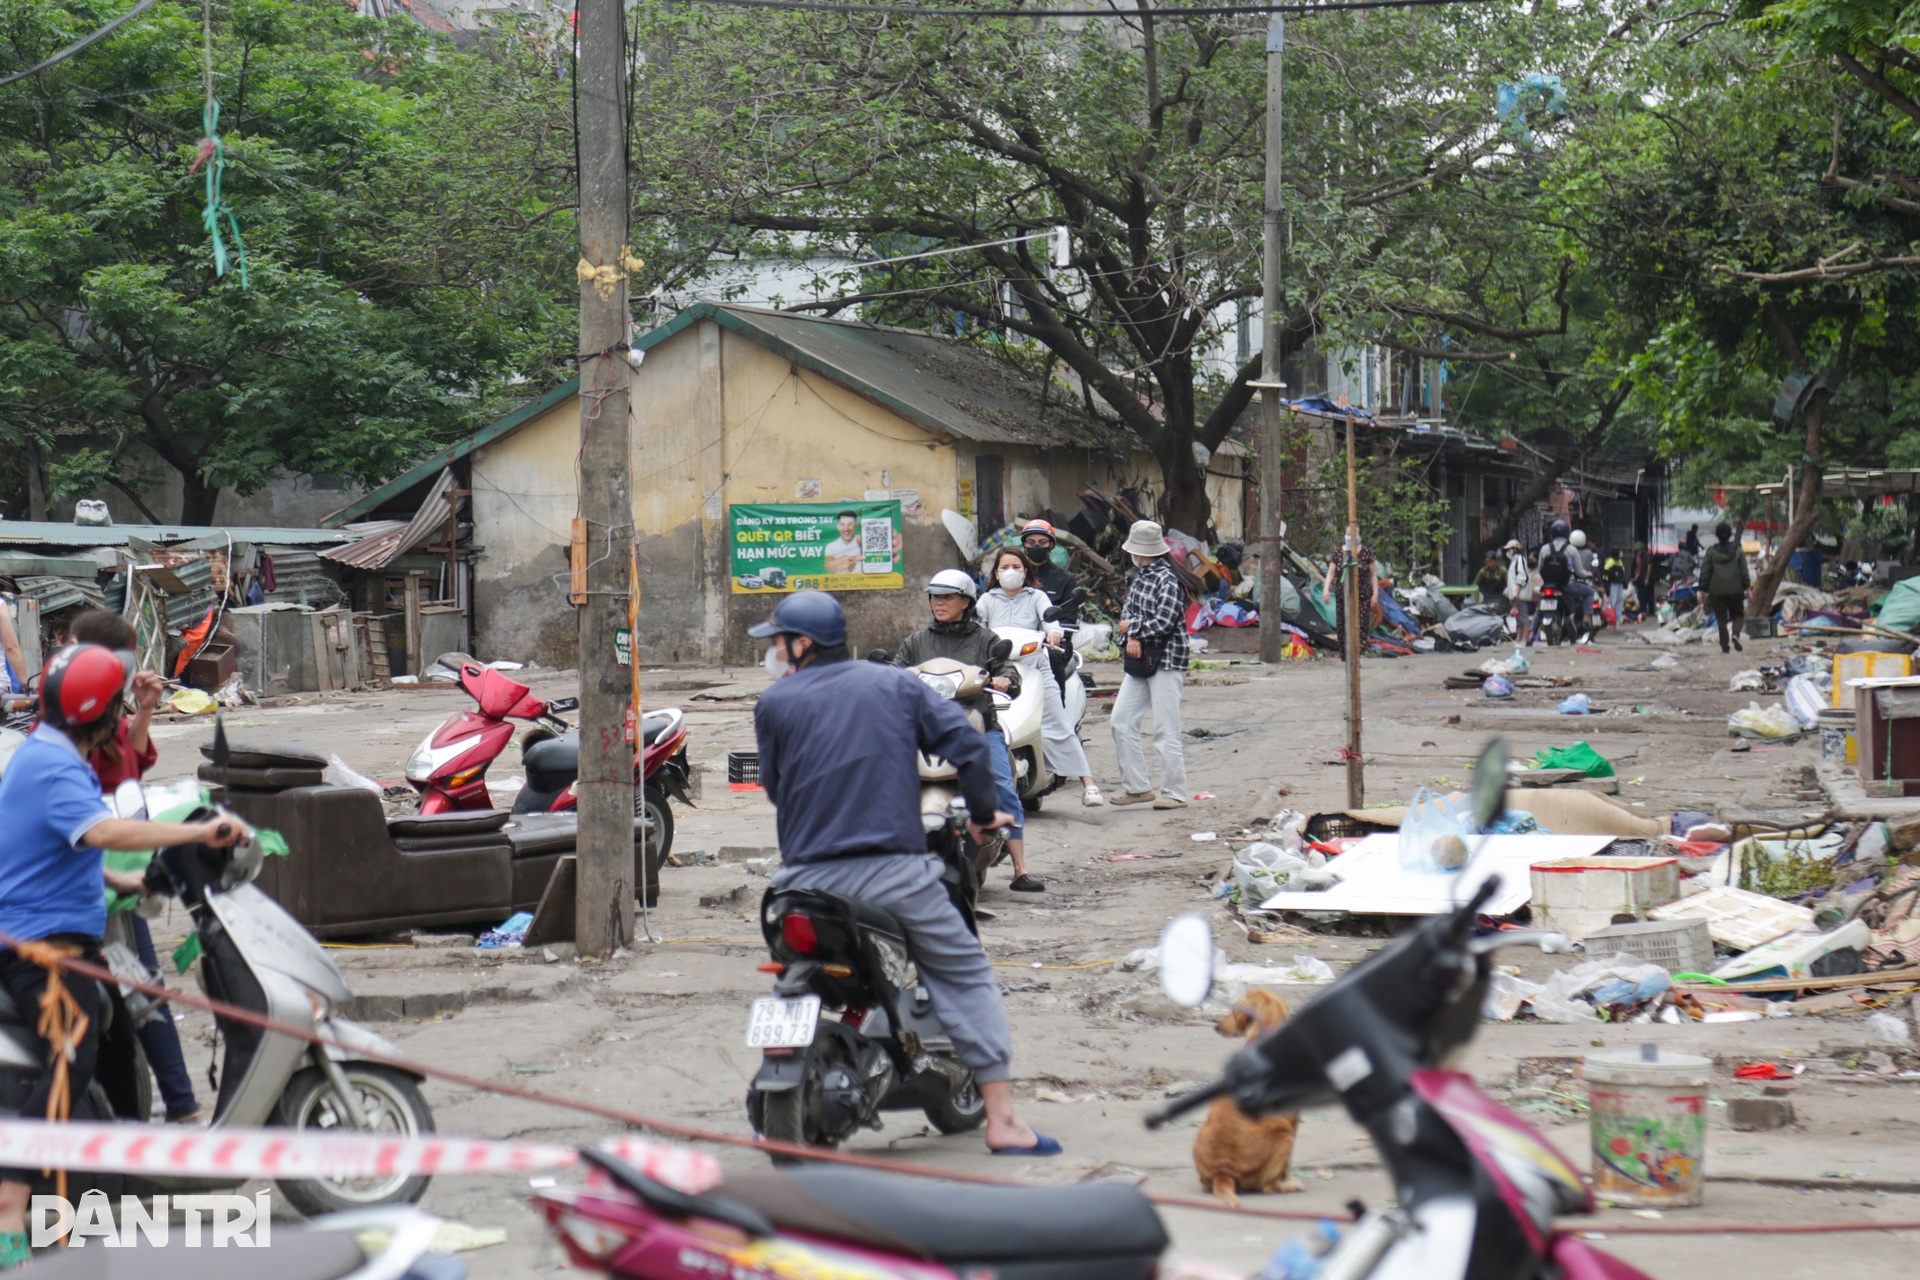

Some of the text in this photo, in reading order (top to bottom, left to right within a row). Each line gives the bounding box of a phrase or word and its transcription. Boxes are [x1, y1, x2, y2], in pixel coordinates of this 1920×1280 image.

[736, 516, 761, 526] ĐĂNG
[775, 517, 786, 525] XE
[787, 516, 818, 525] TRONG
[818, 516, 834, 524] TAY
[773, 530, 793, 542] QR
[795, 526, 822, 541] BIẾT
[737, 544, 823, 562] HẠN MỨC VAY
[793, 578, 819, 589] F88
[459, 789, 482, 800] HONDA
[751, 1023, 810, 1045] 899.73
